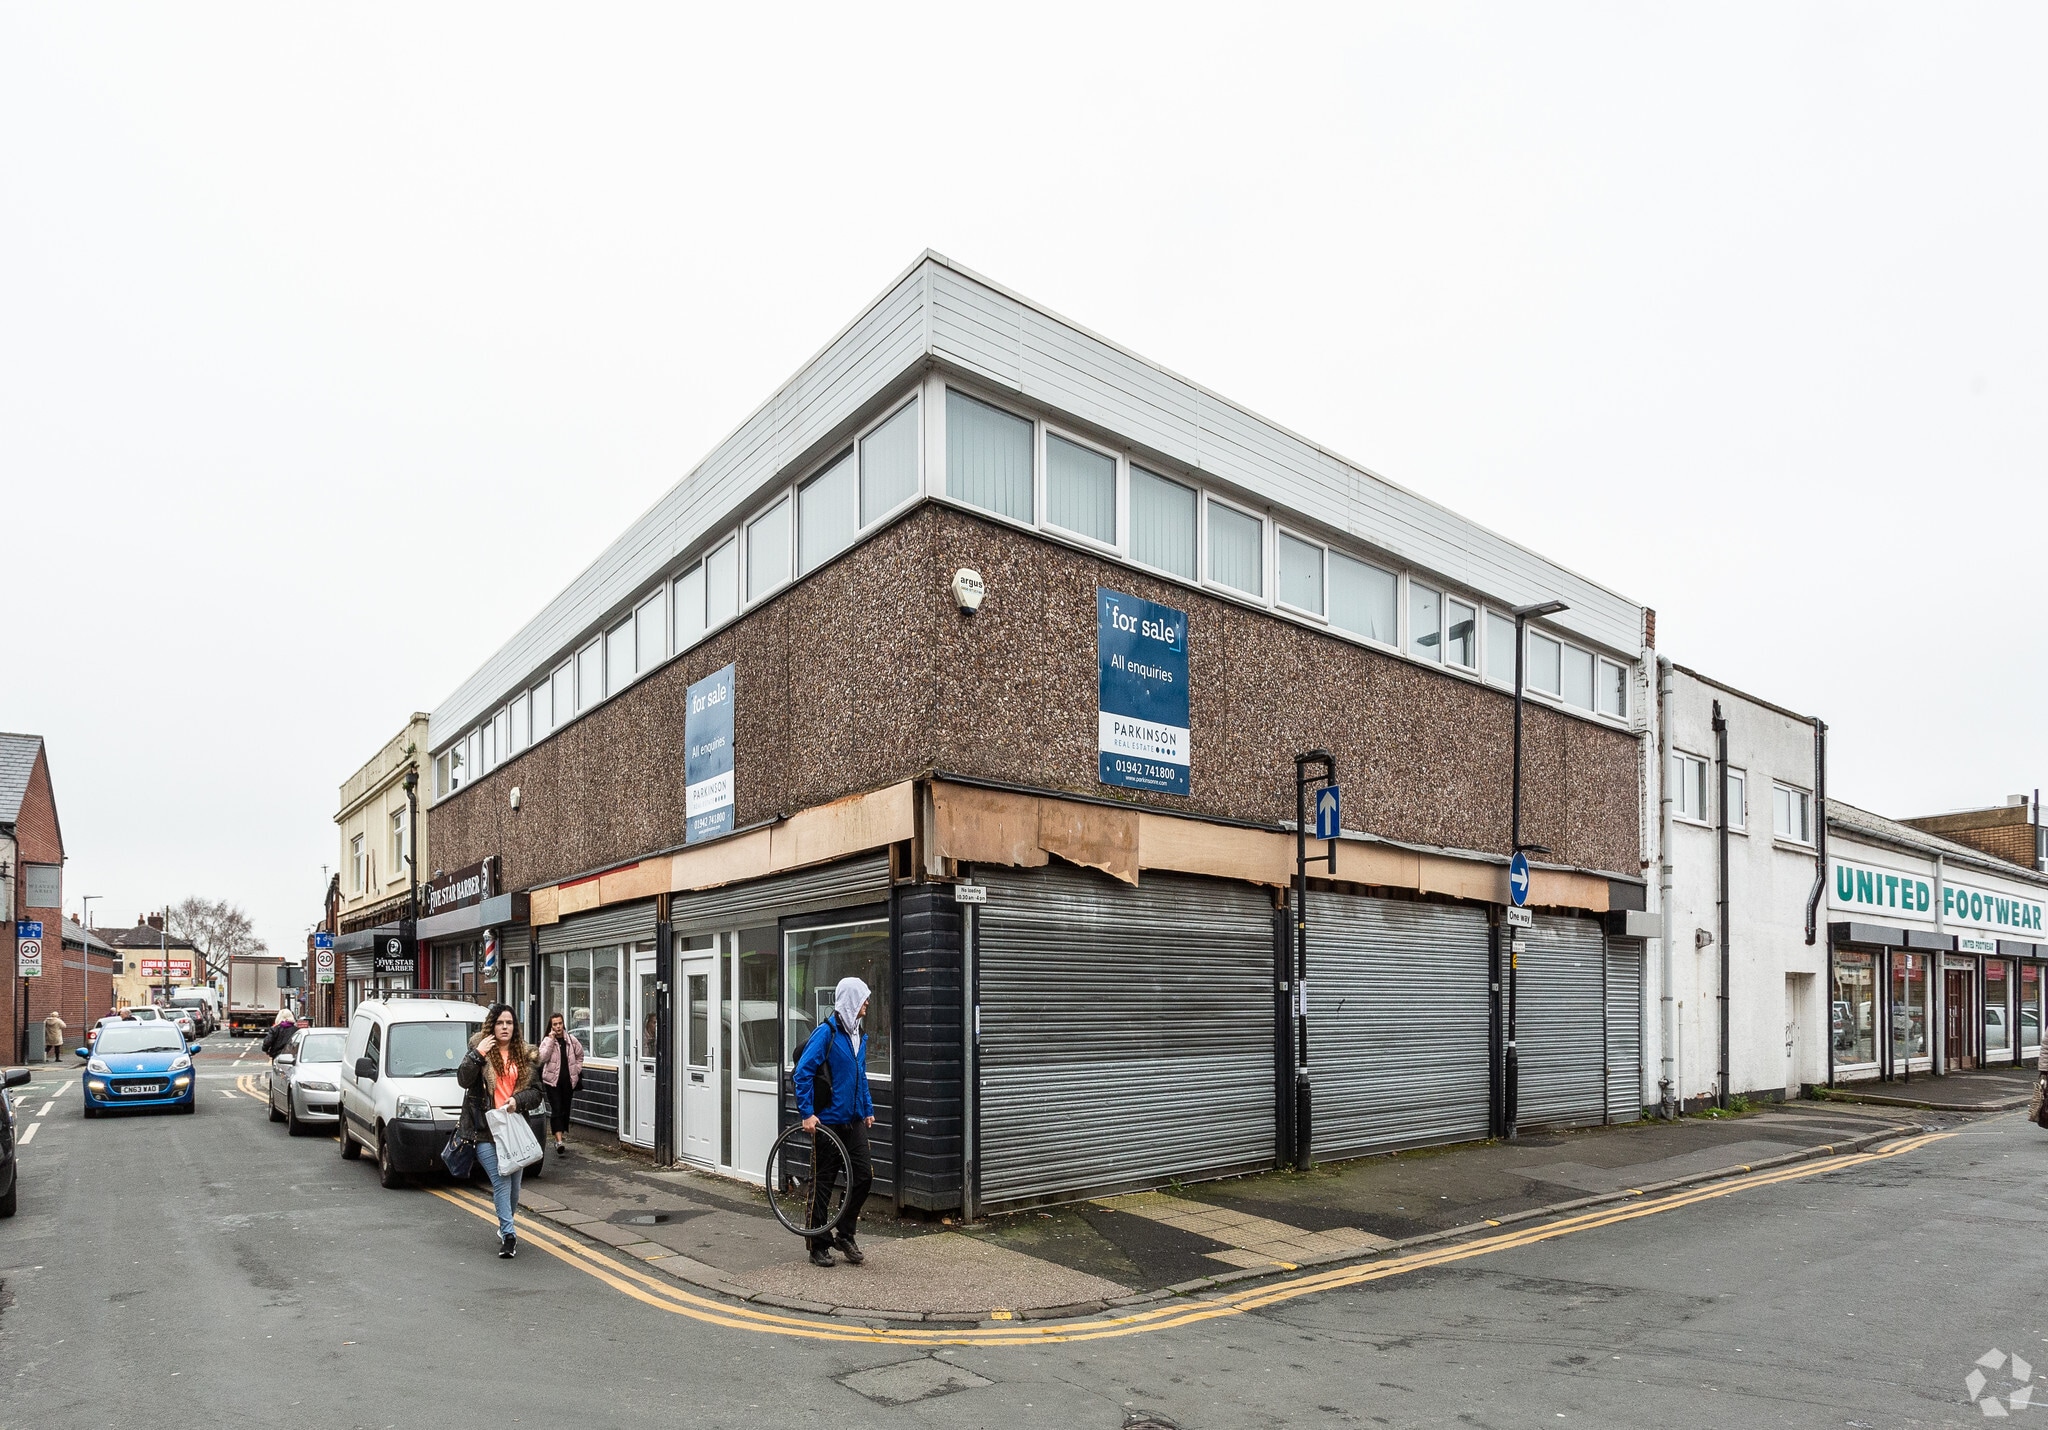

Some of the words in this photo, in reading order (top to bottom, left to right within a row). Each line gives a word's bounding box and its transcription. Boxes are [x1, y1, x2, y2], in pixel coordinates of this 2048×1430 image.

[960, 577, 982, 588] argus
[1112, 605, 1138, 634] for
[1141, 618, 1175, 644] sale
[1111, 653, 1125, 672] All
[1127, 660, 1173, 683] enquiries
[692, 694, 706, 714] for
[707, 683, 727, 707] sale
[691, 744, 700, 759] All
[700, 736, 726, 759] enquiries
[1114, 738, 1130, 749] REAL
[1132, 743, 1155, 753] ESTATE
[1115, 759, 1142, 775] 01942
[1144, 764, 1175, 780] 741800
[428, 888, 442, 914] FIVE
[441, 875, 457, 905] STAR
[456, 874, 480, 900] BARBER
[1837, 865, 1930, 912] UNITED
[1943, 887, 2042, 931] FOOTWEAR
[1509, 910, 1519, 921] One
[1520, 914, 1530, 925] way
[23, 945, 38, 954] 20
[320, 955, 331, 963] 20
[378, 958, 395, 968] FIVE
[123, 1086, 142, 1094] CN63
